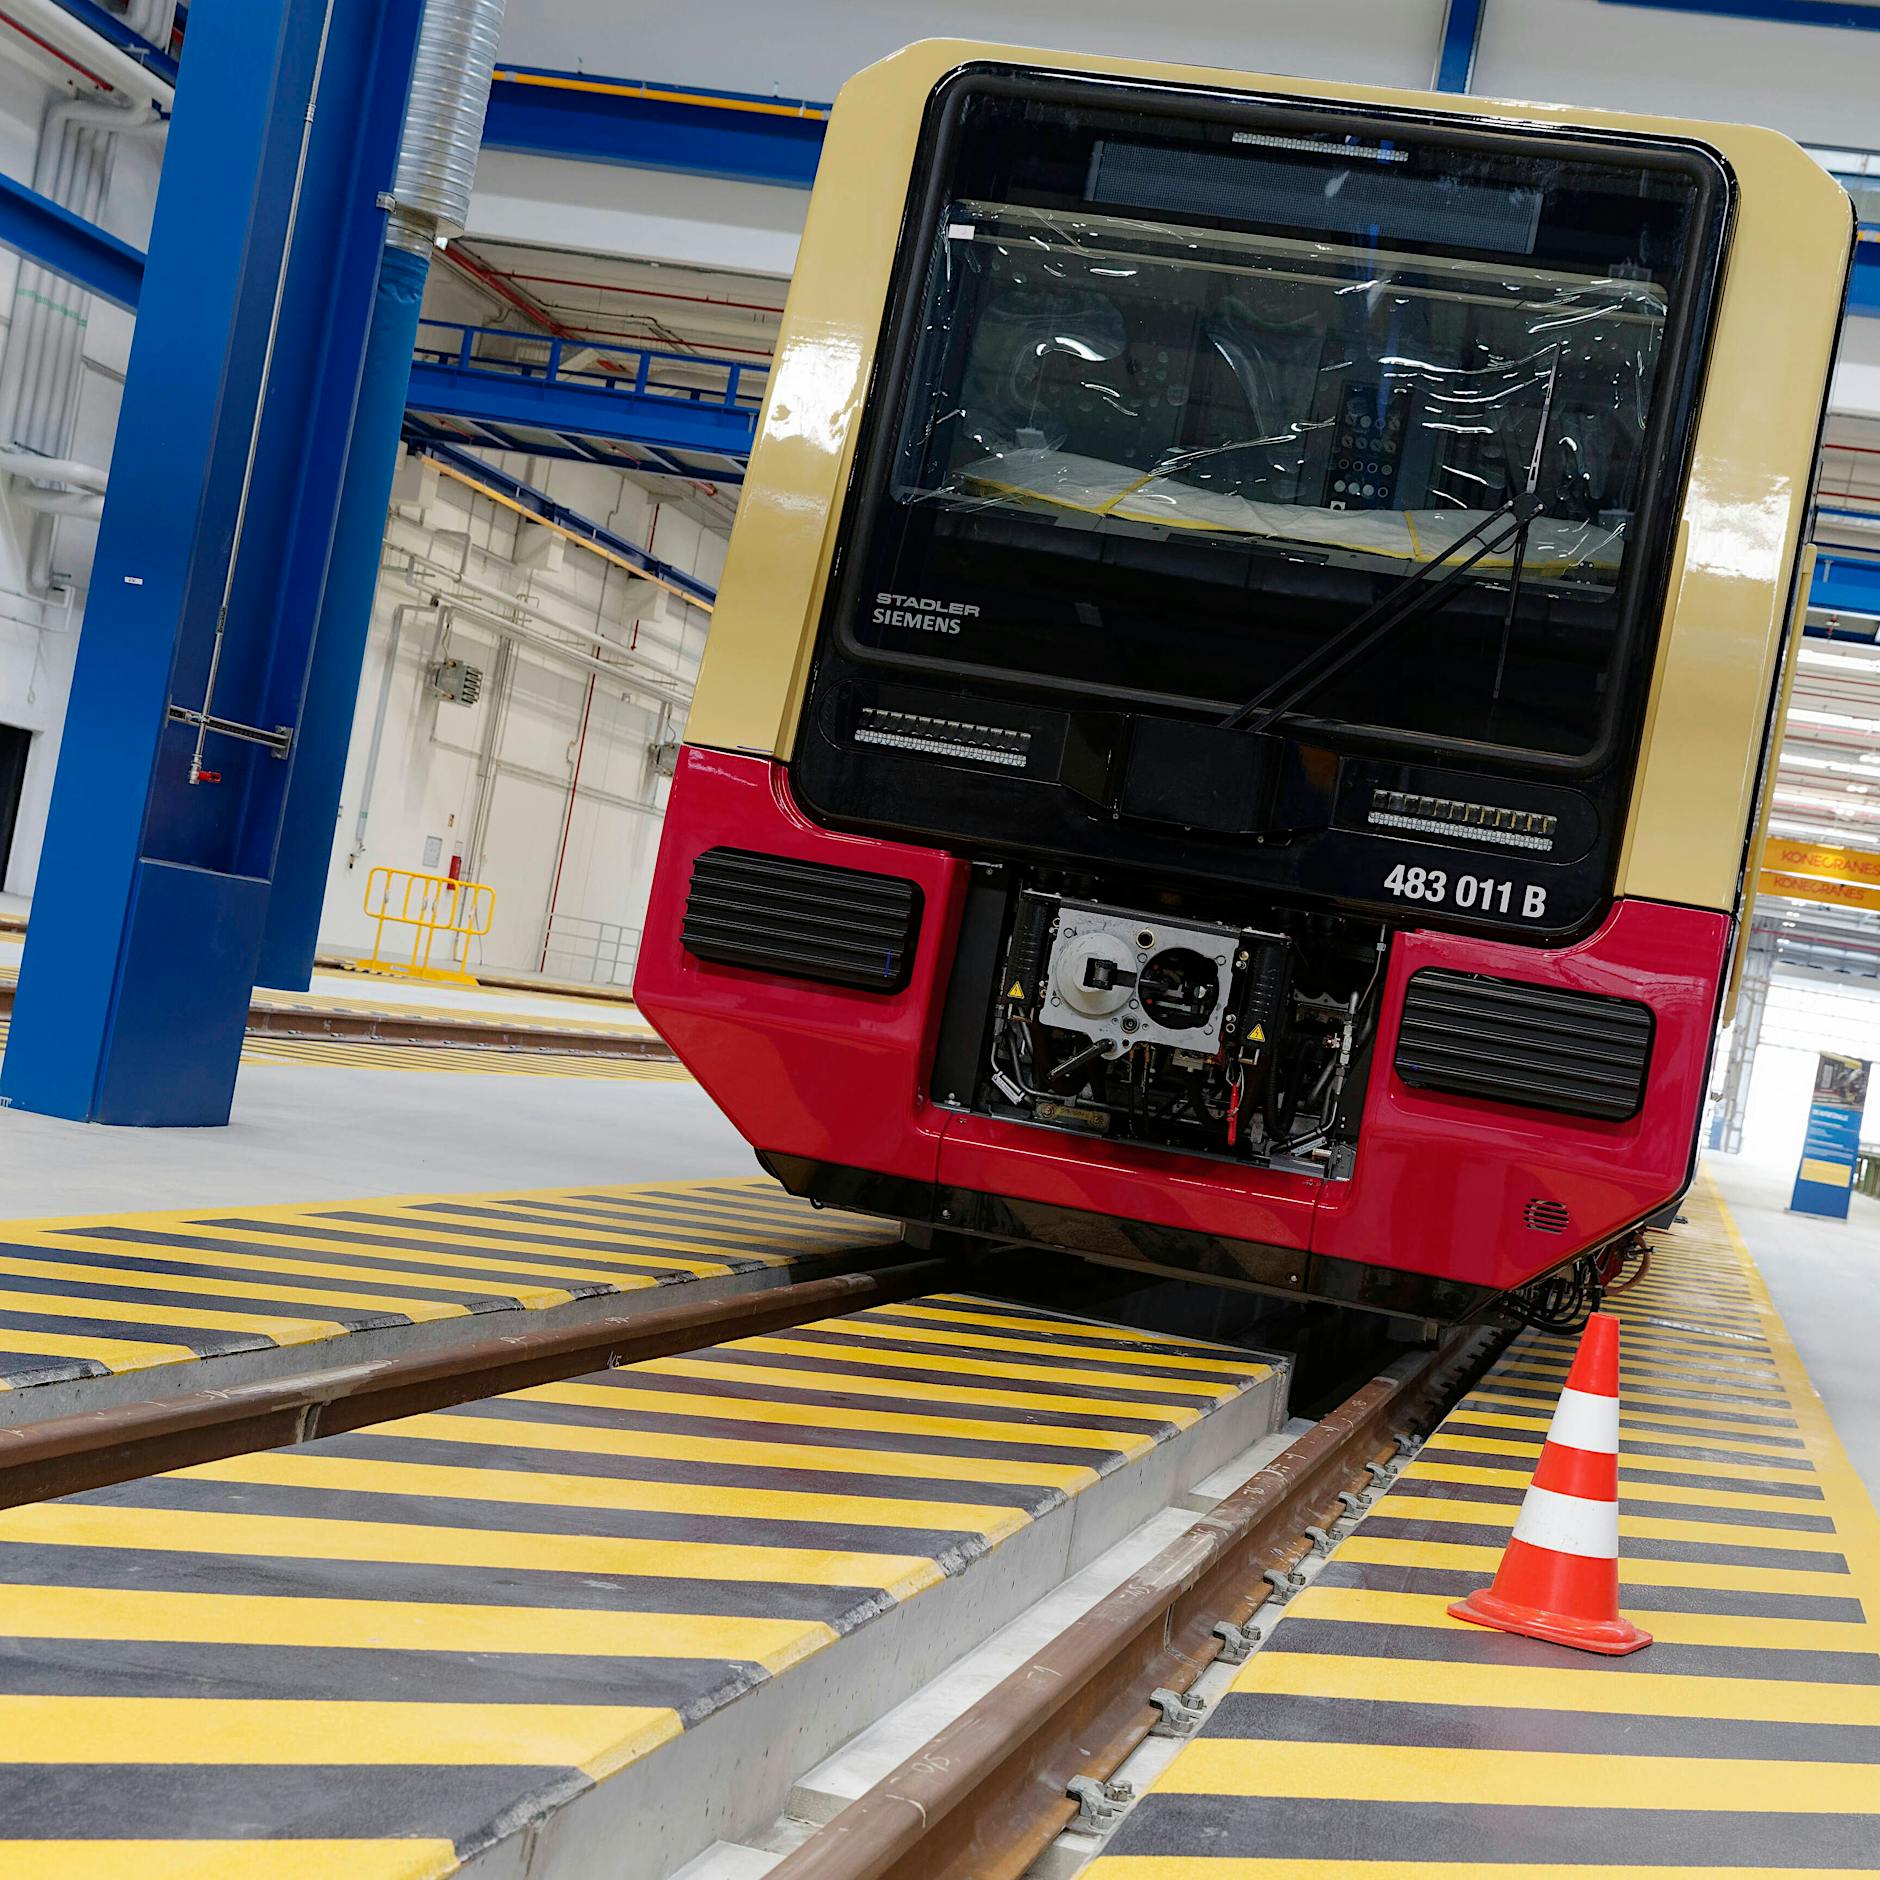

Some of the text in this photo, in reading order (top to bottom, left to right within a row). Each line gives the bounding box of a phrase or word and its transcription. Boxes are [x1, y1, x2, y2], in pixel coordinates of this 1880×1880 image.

[876, 593, 980, 617] STADLER
[872, 608, 960, 634] SIEMENS
[1383, 864, 1547, 918] 483 011 B
[1774, 876, 1864, 900] KONECRANES
